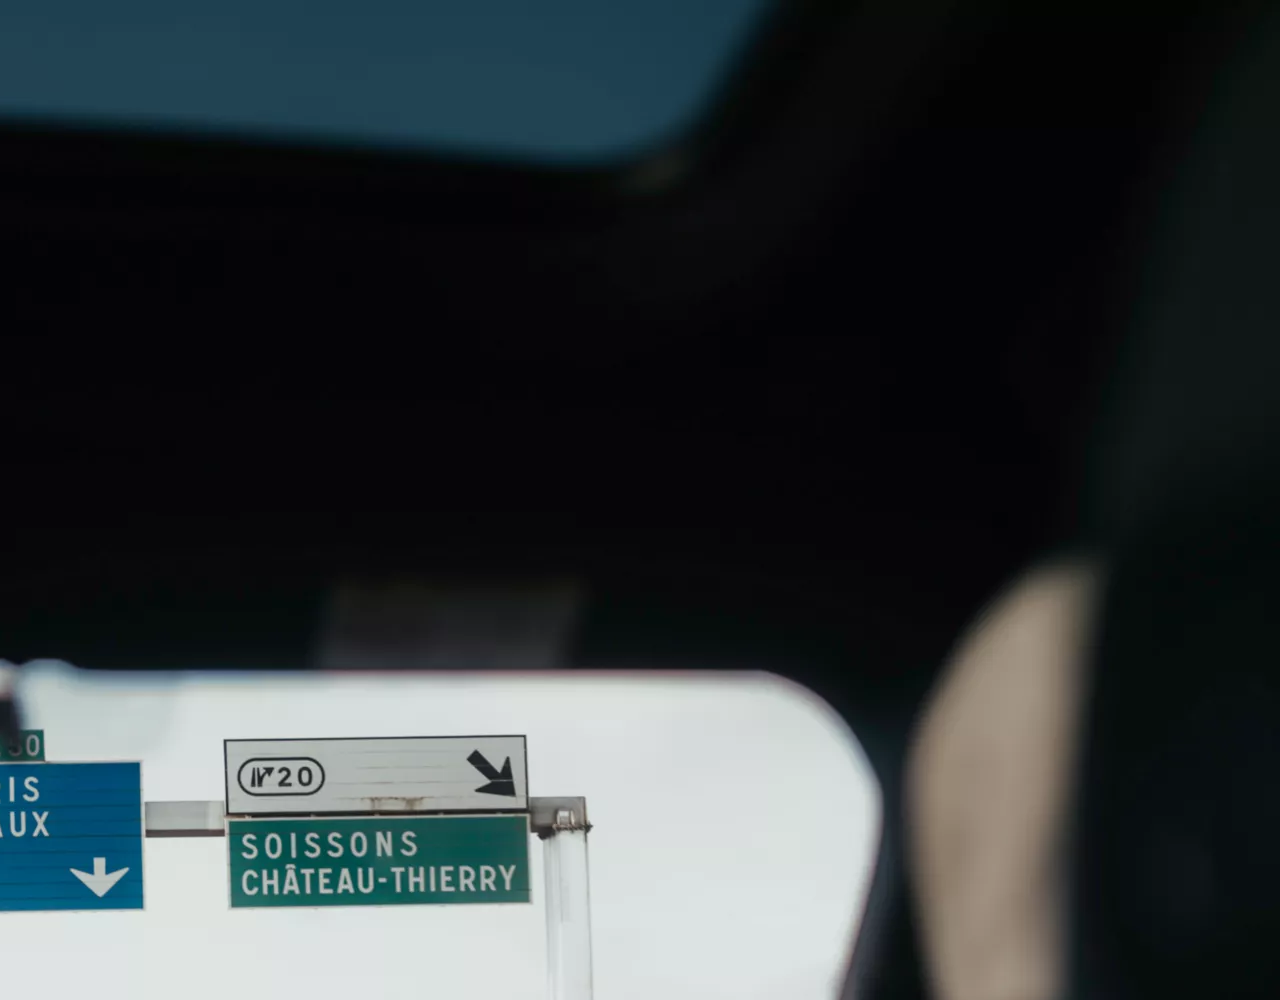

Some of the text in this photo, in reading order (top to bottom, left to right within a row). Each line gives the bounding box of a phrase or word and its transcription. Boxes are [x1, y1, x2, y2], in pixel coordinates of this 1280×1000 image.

[277, 766, 313, 787] 20
[241, 831, 418, 859] SOISSONS
[241, 864, 517, 896] CHÂTEAU-THIERRY
